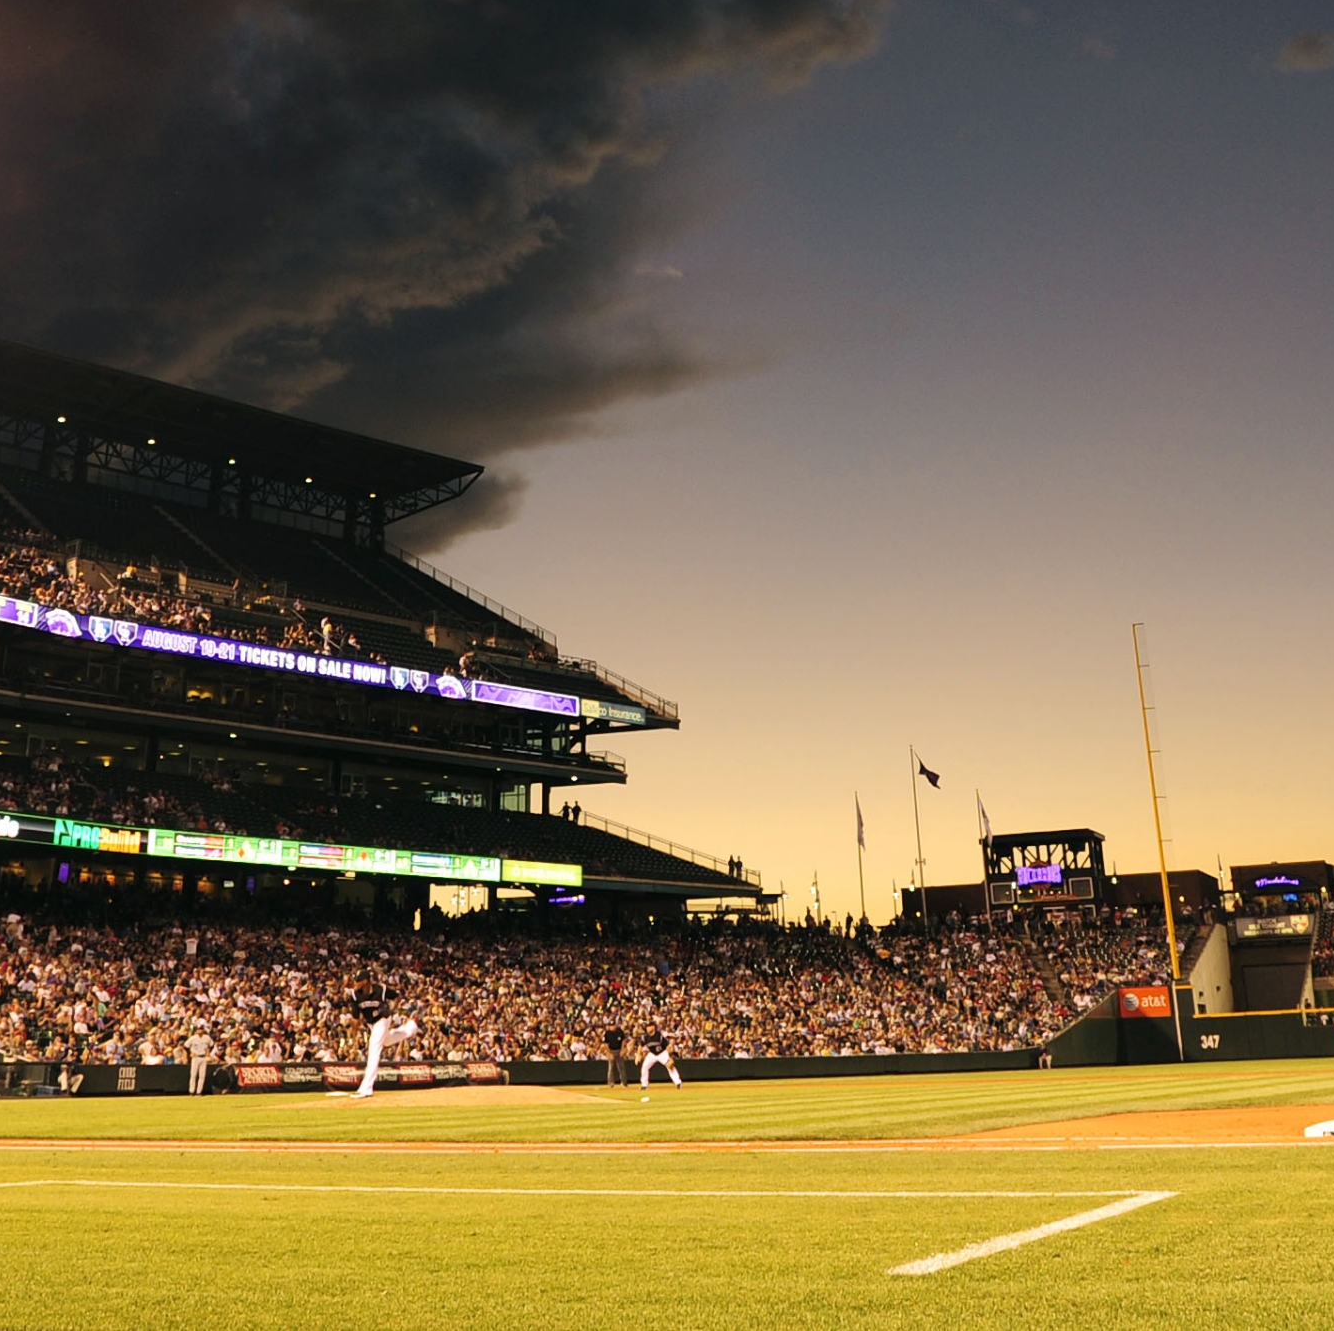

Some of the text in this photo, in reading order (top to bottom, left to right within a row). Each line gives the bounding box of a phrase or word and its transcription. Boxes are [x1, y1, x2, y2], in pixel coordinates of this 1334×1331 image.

[142, 630, 197, 654] AUGUST
[238, 645, 295, 670] TICKETS
[297, 654, 317, 673] ON
[318, 660, 351, 680] SALE
[353, 665, 386, 684] NOW!
[1141, 994, 1167, 1008] at&t
[1200, 1035, 1220, 1049] 347
